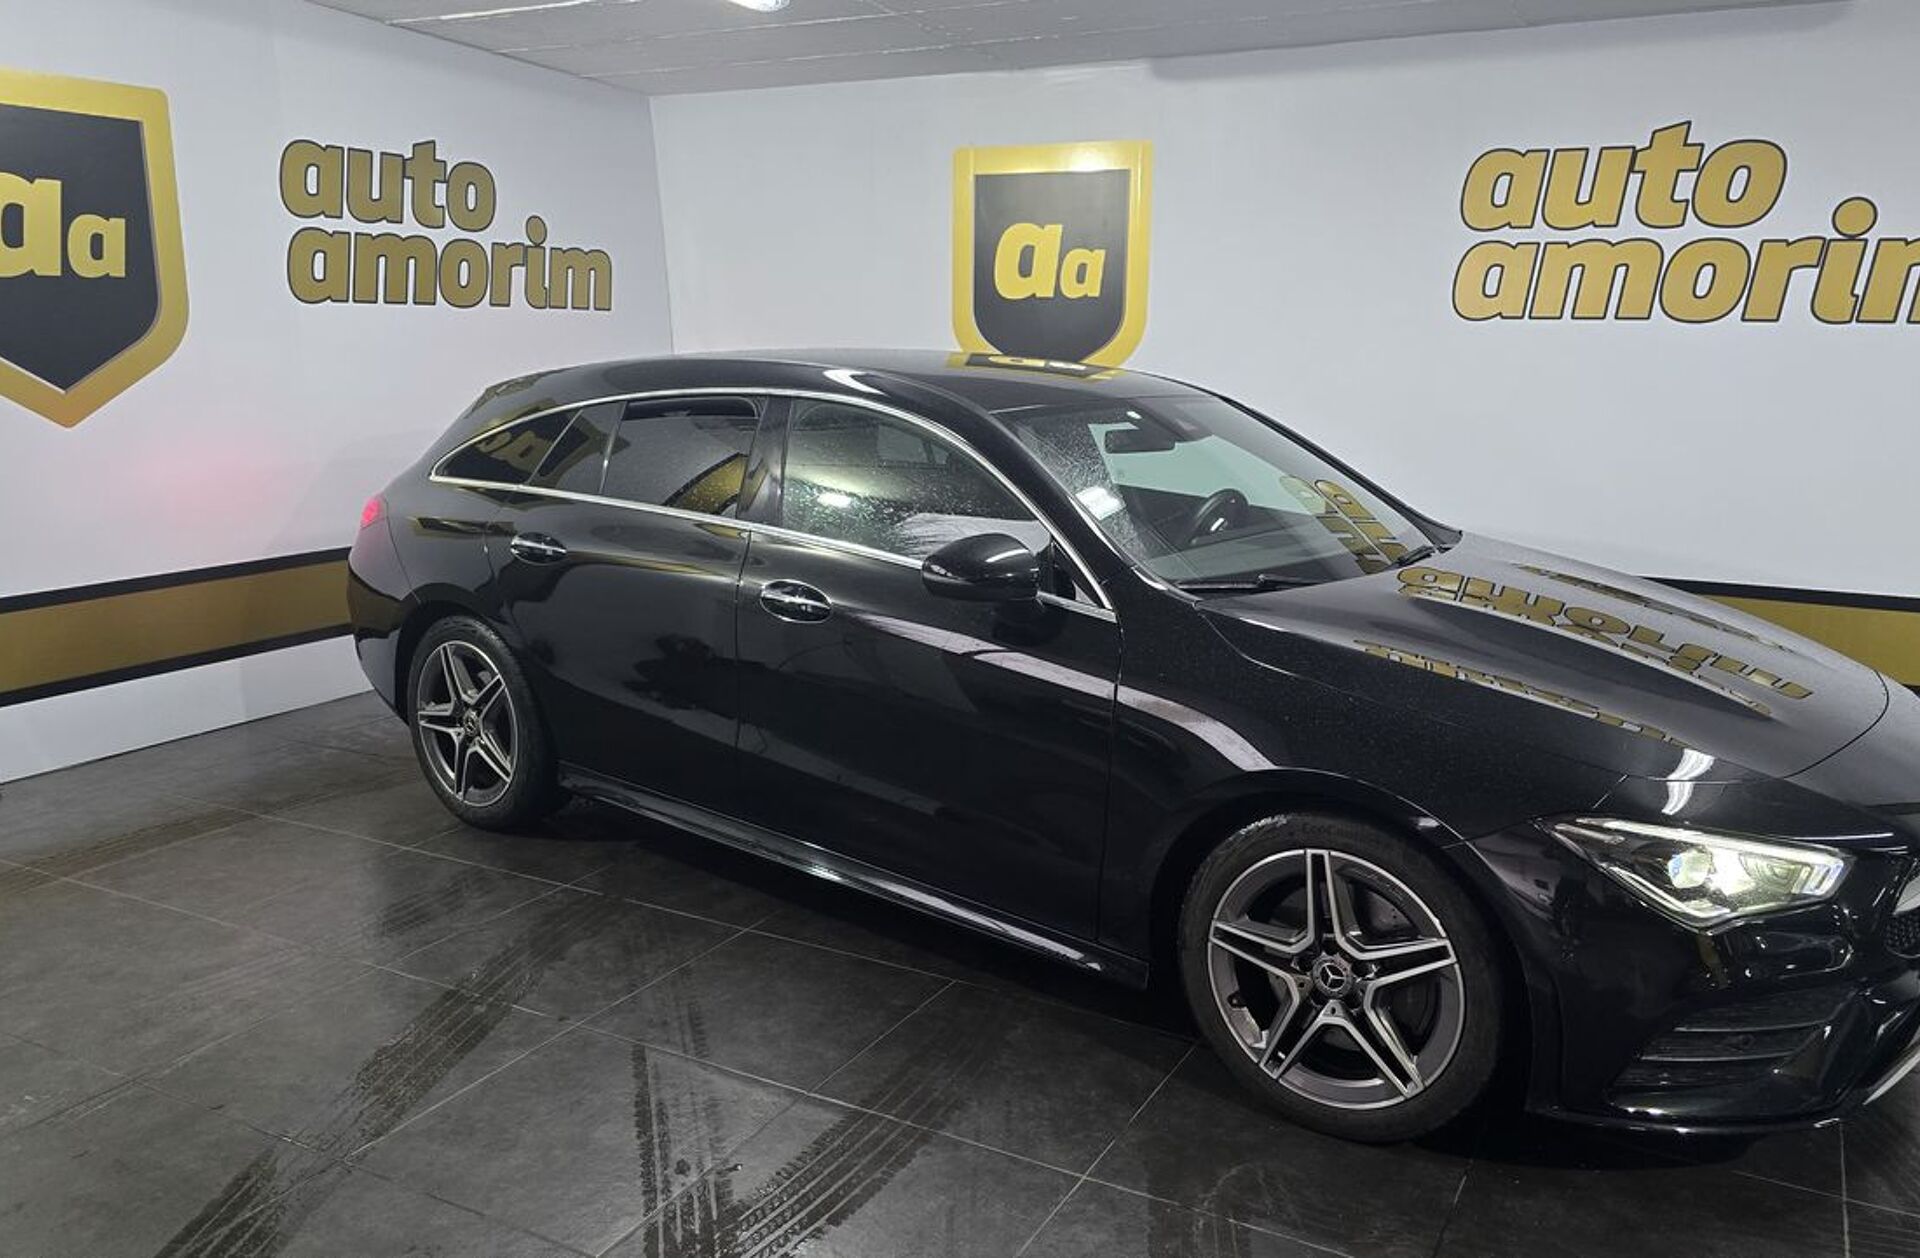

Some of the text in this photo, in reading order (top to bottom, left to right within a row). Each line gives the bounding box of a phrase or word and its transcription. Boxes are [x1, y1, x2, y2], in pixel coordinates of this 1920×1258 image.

[280, 139, 496, 232] auto
[1461, 121, 1787, 231] auto
[287, 215, 612, 311] amorim
[994, 222, 1106, 300] aa
